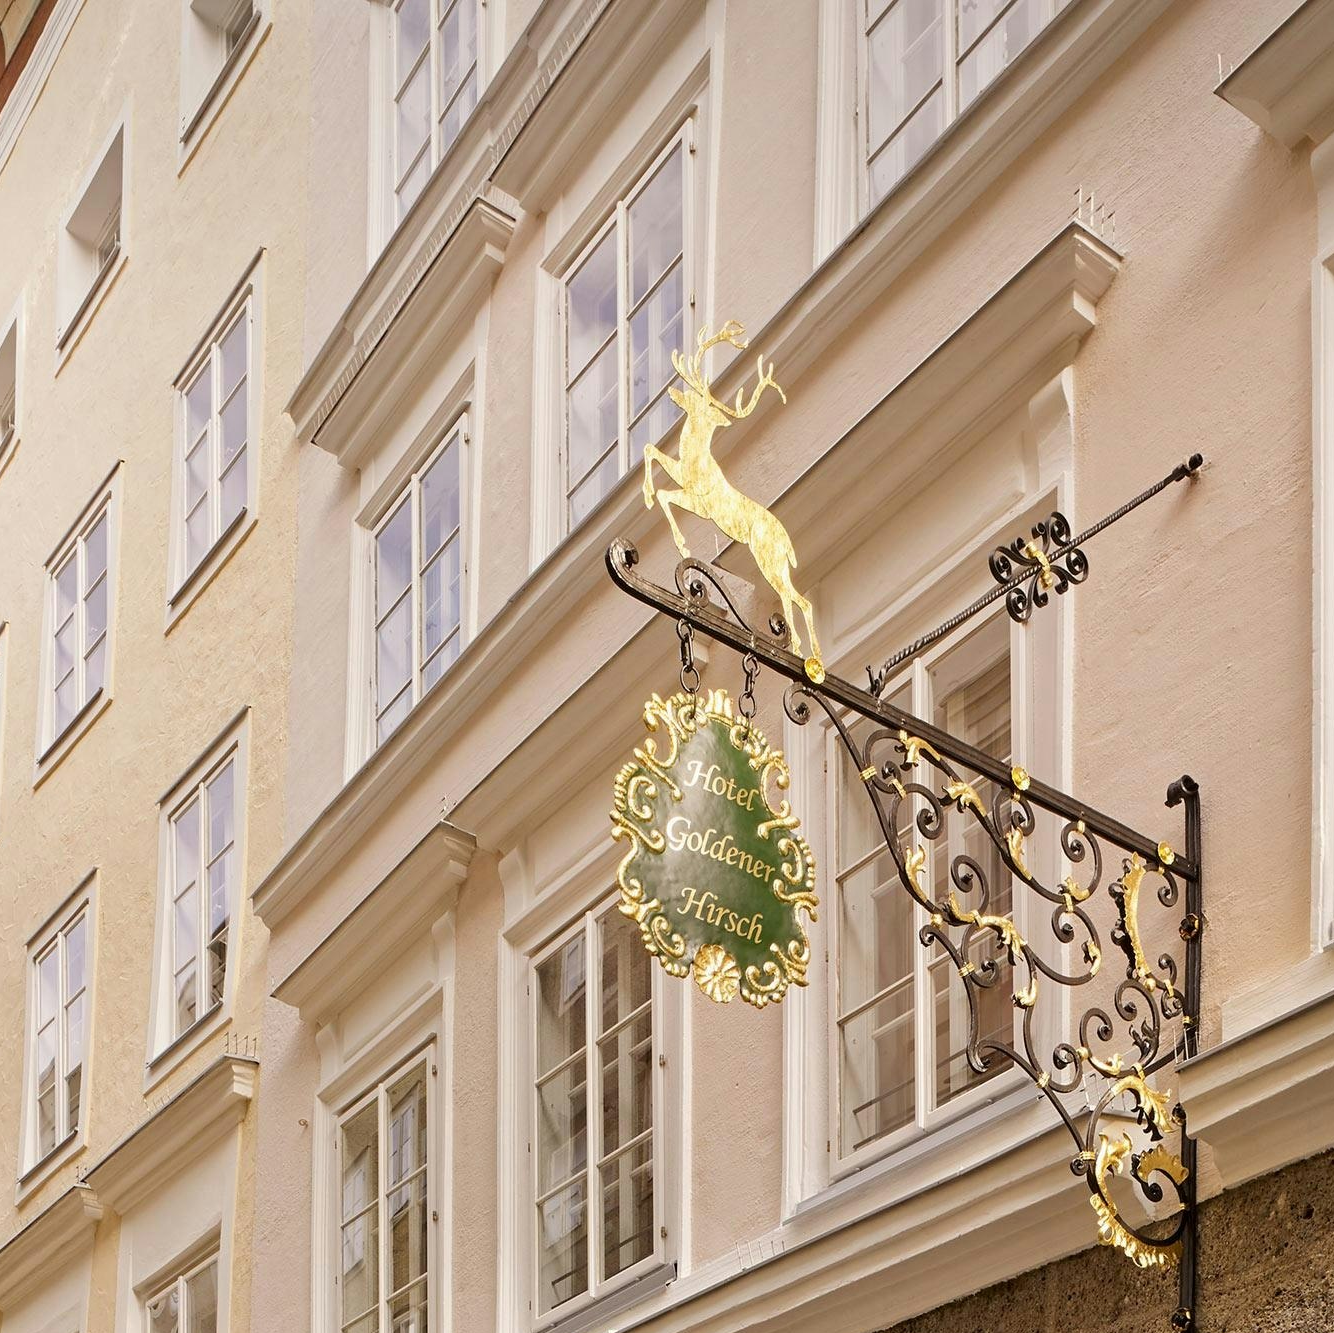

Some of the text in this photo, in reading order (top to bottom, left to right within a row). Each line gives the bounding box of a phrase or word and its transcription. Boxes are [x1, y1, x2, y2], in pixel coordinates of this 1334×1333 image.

[683, 760, 759, 812] Hotel
[666, 816, 776, 883] Goldener
[677, 887, 764, 944] Hirsch
